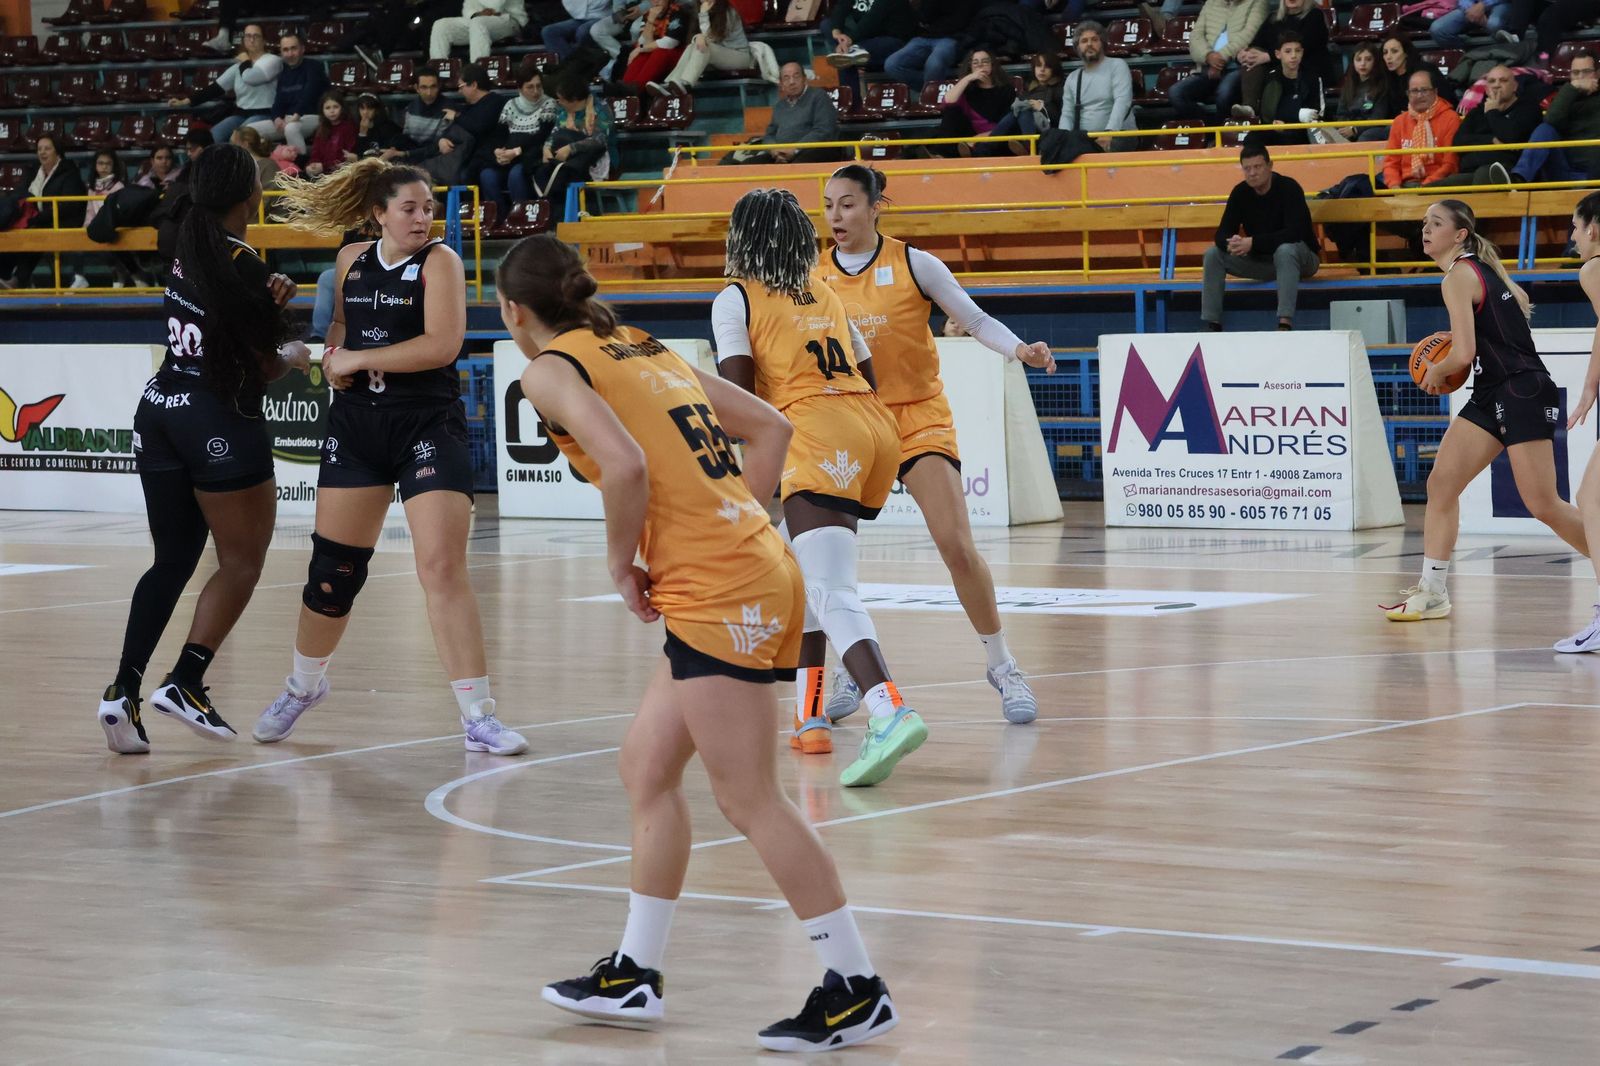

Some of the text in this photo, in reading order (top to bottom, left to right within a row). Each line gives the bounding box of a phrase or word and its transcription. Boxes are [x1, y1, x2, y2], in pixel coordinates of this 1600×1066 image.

[1124, 21, 1139, 34] 16
[343, 66, 356, 75] 42
[525, 203, 540, 215] 26
[380, 293, 413, 307] Cajasol
[805, 336, 855, 381] 14
[368, 370, 386, 393] 8
[274, 436, 324, 449] Embutidos y
[11, 458, 41, 468] CENTRO
[46, 458, 88, 469] COMERCIAL
[92, 459, 102, 470] DE
[107, 459, 137, 471] ZAMOR
[506, 469, 562, 483] GIMNASIO
[1112, 467, 1152, 479] Avenida
[1154, 468, 1177, 479] Tres
[1179, 468, 1214, 479] Cruces
[1217, 468, 1228, 479] 17
[1231, 469, 1252, 479] Entr
[1254, 469, 1260, 479] 1
[1269, 469, 1300, 480] 49008
[1302, 469, 1343, 481] Zamora
[1139, 485, 1332, 500] marianandresasesoria@gmail.com
[1138, 503, 1163, 519] 980
[1166, 503, 1184, 519] 05
[1188, 504, 1205, 519] 85
[1209, 504, 1226, 519] 90
[1240, 505, 1266, 520] 605
[1271, 505, 1288, 520] 76
[1292, 506, 1310, 521] 71
[1314, 506, 1332, 521] 05
